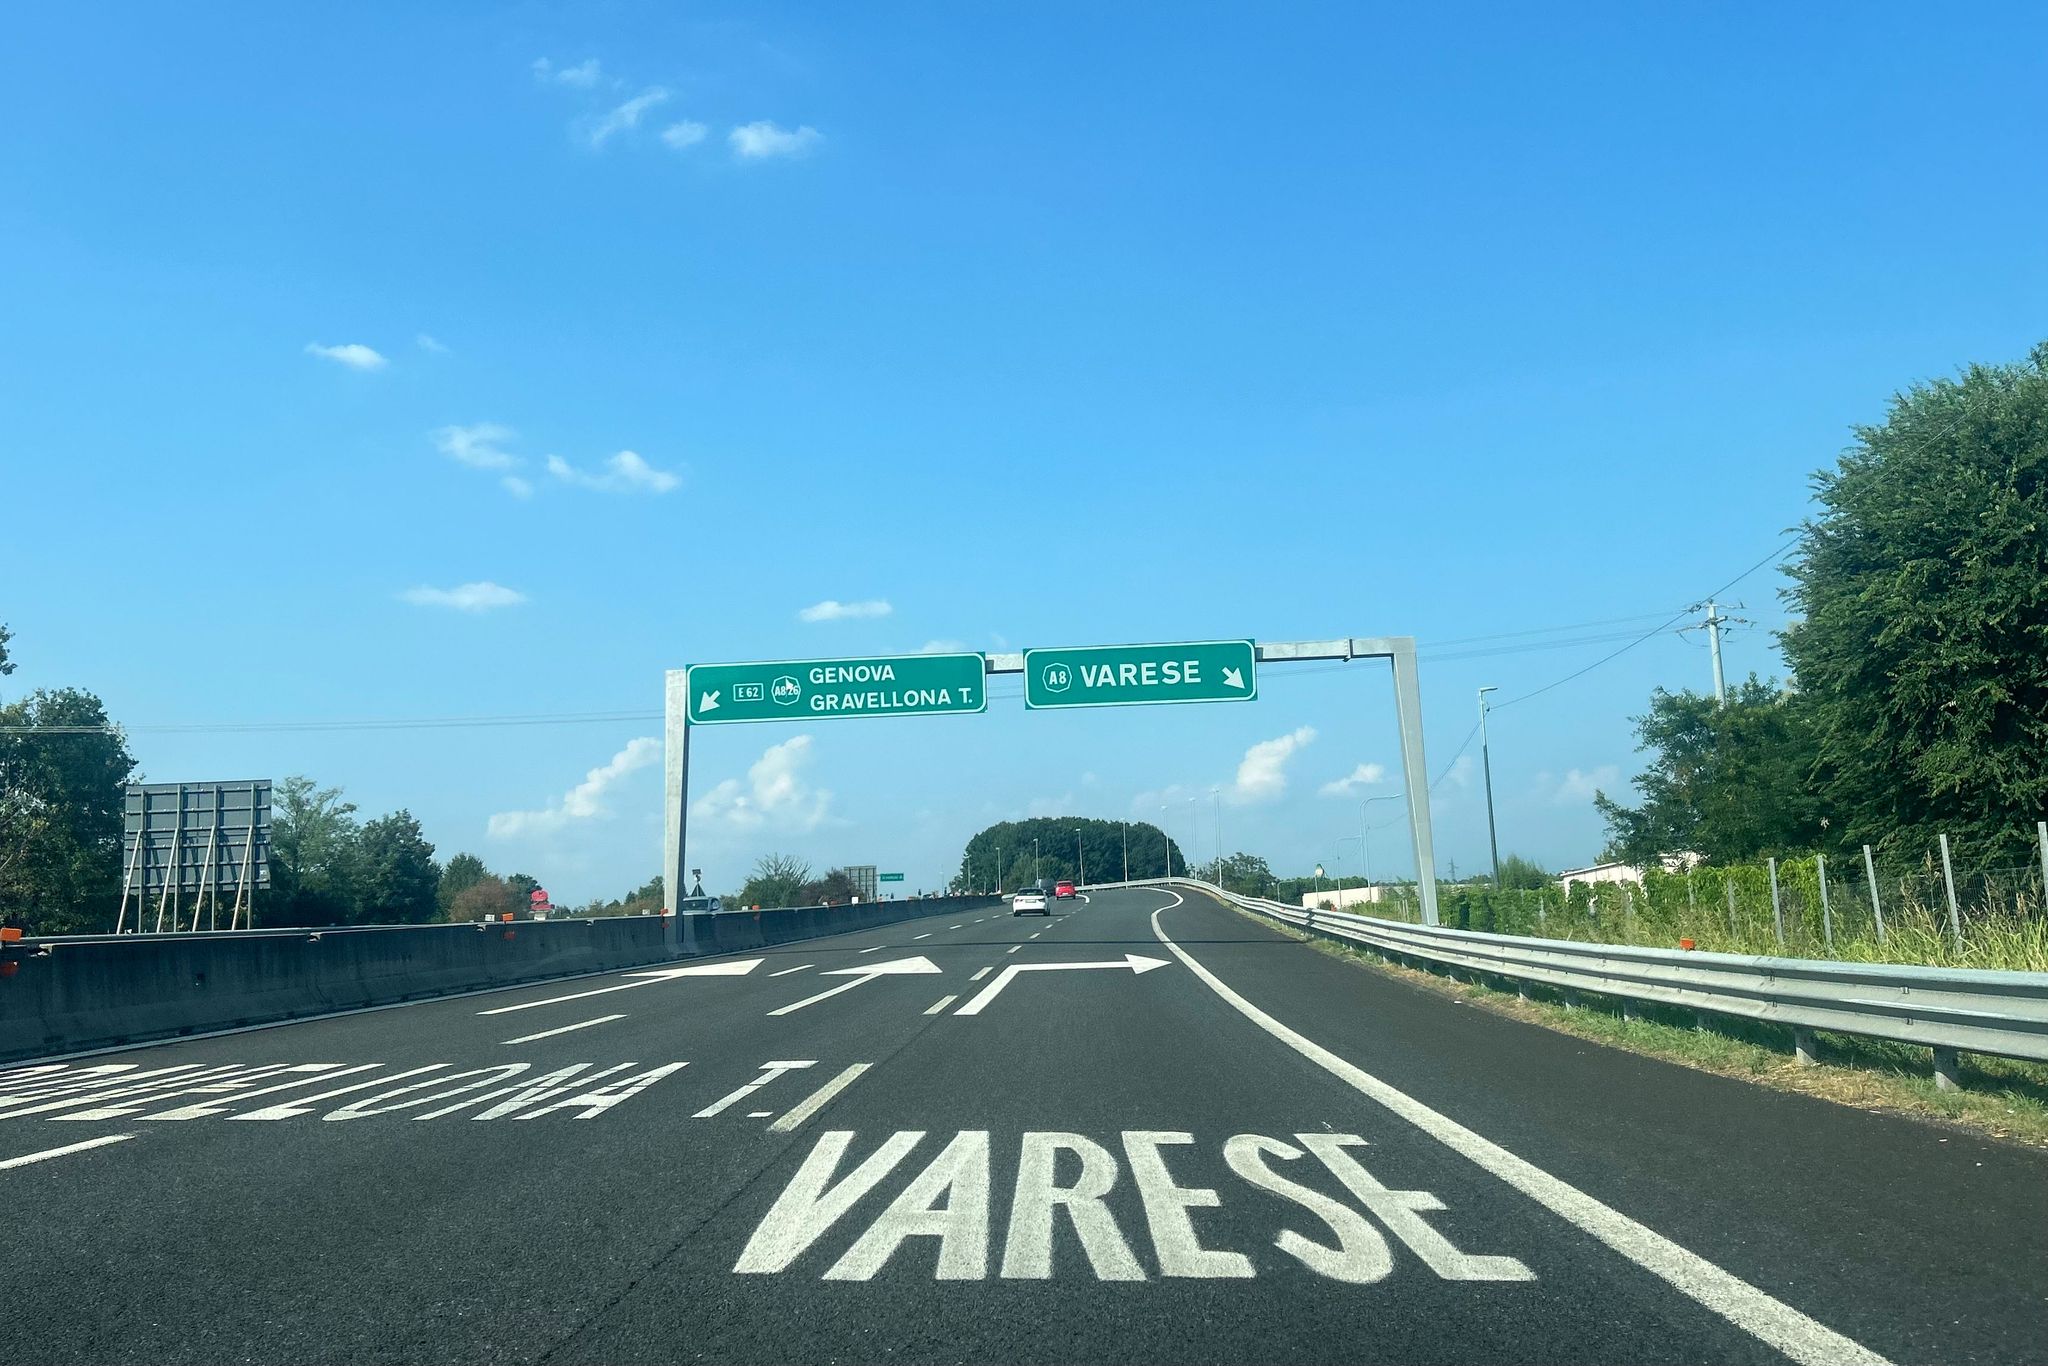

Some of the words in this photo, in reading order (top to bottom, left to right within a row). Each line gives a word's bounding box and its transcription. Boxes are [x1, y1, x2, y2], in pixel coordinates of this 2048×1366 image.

[809, 664, 896, 684] GENOVA
[1049, 670, 1067, 685] A8
[1080, 660, 1201, 687] VARESE
[738, 688, 744, 698] E
[747, 687, 759, 698] 62
[810, 688, 951, 711] GRAVELLONA
[958, 687, 973, 704] T.
[691, 1060, 819, 1118] T.
[733, 1130, 1537, 1283] VARESE
